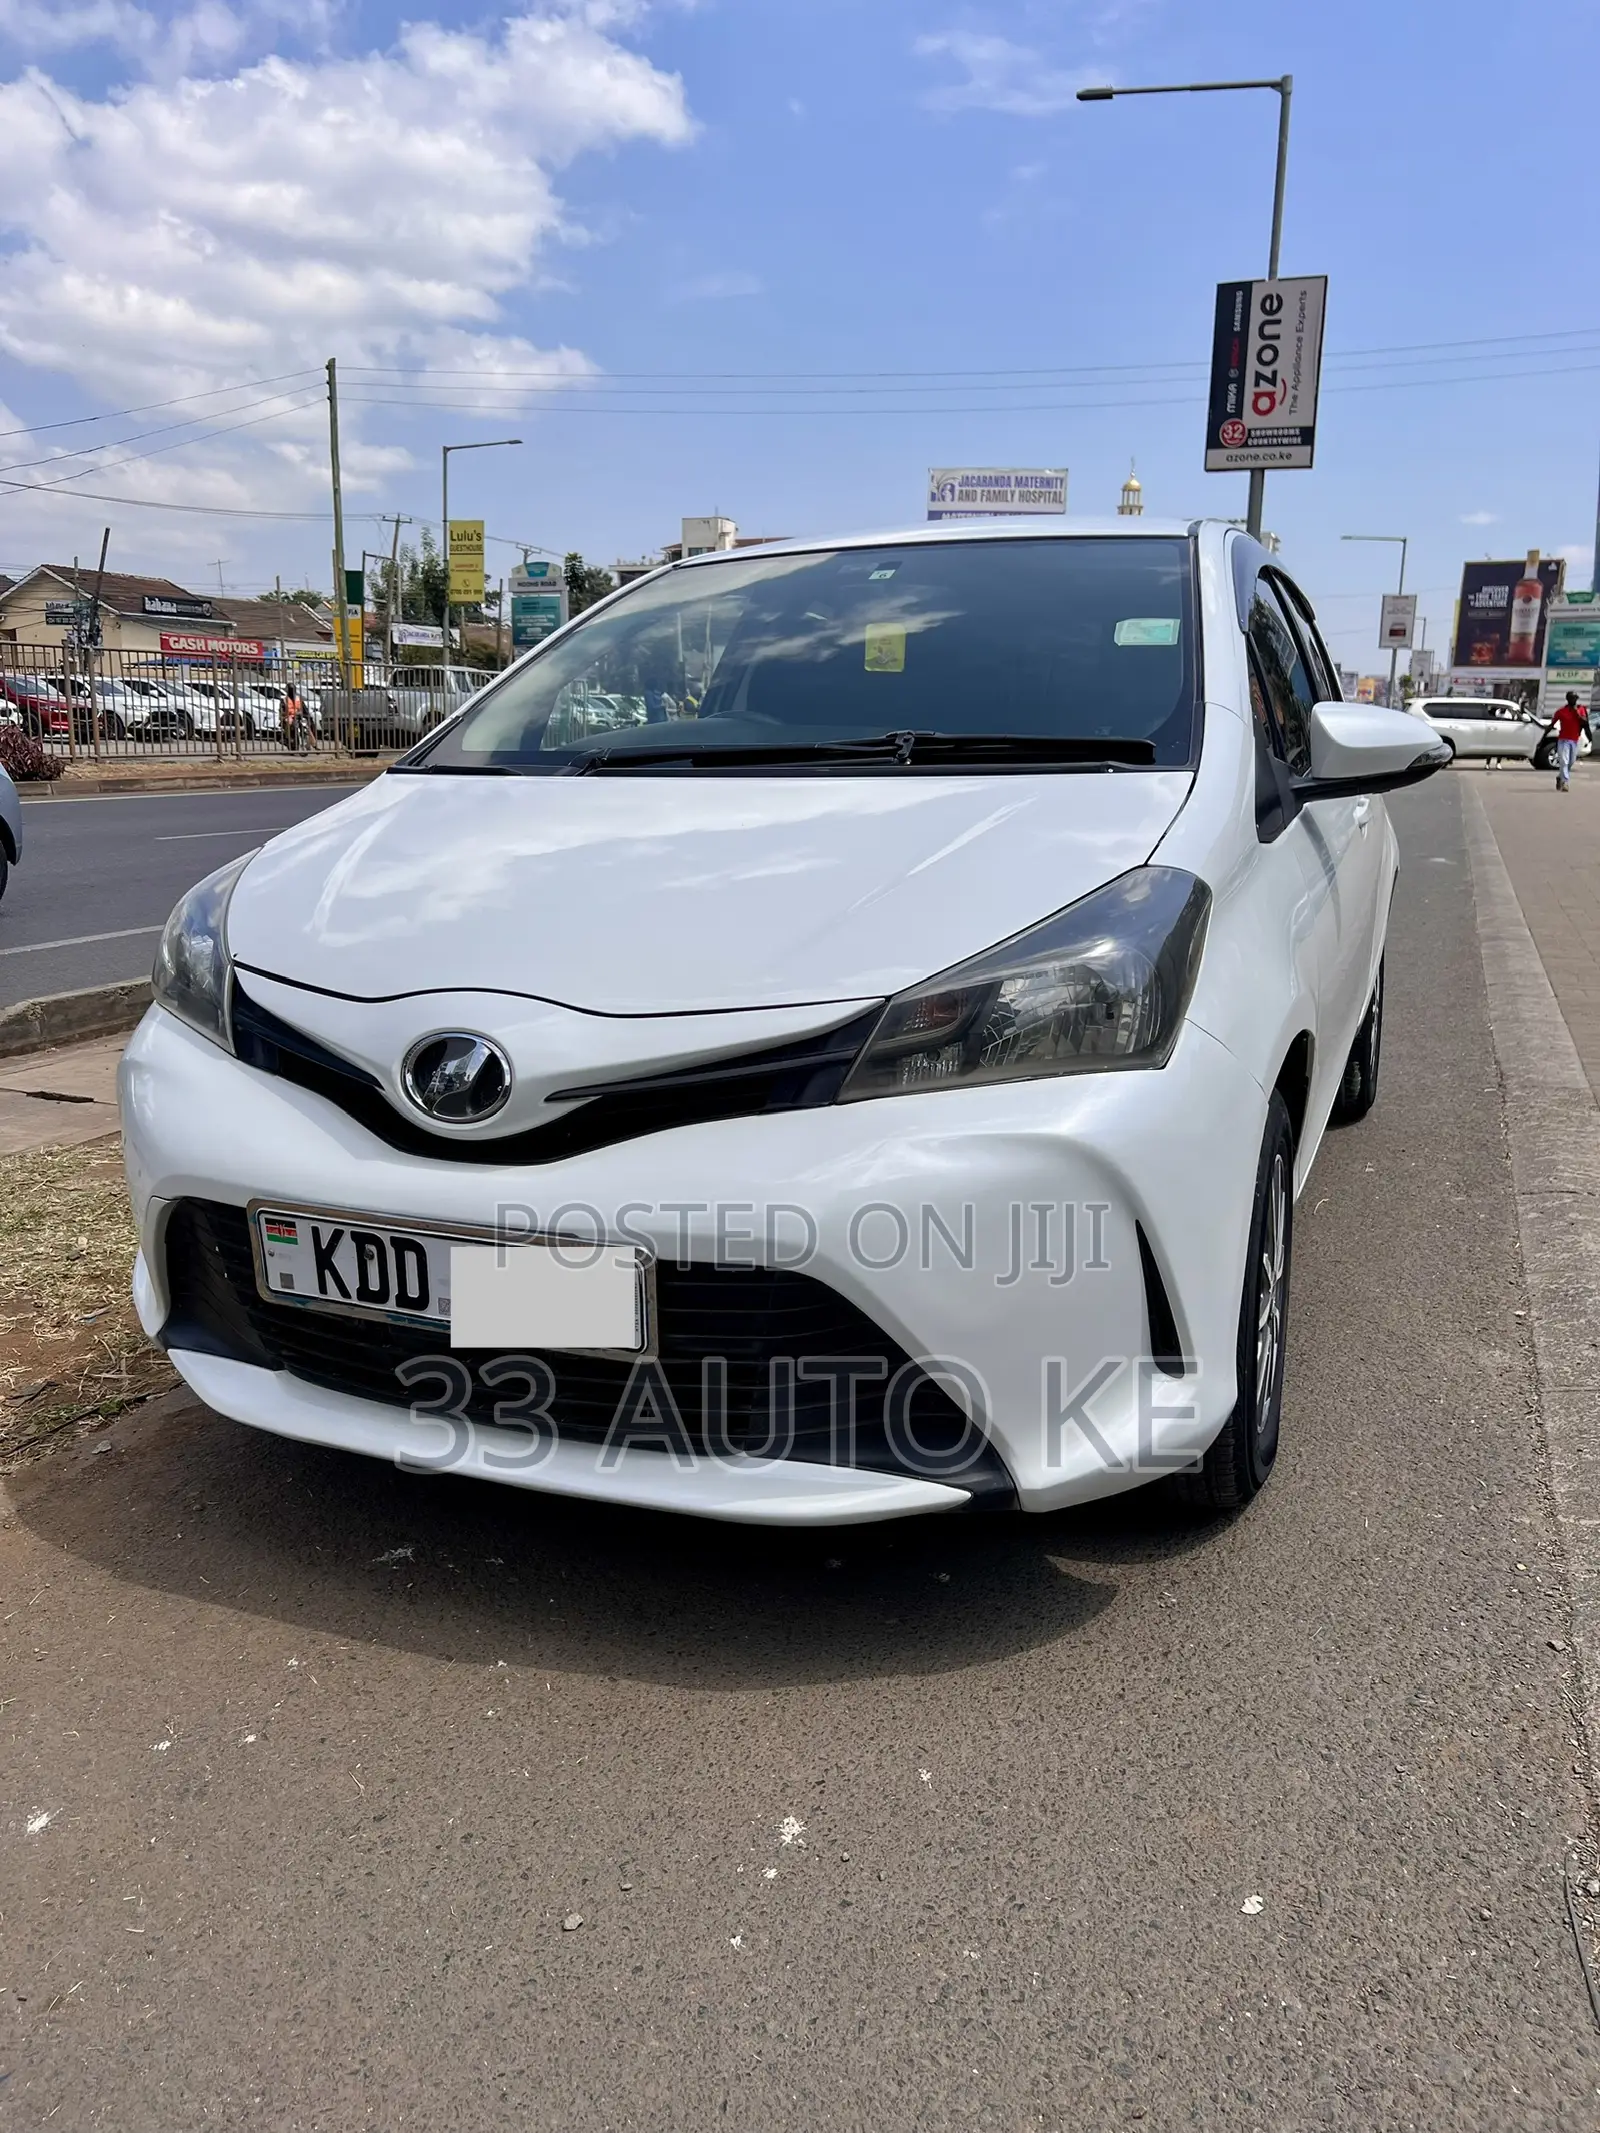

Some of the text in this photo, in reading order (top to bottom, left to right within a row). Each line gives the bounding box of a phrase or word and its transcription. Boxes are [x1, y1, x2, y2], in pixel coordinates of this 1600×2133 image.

[1252, 292, 1283, 417] azone
[1289, 290, 1308, 415] The Appliance Experts
[1223, 424, 1243, 439] 32
[1250, 428, 1300, 437] SHOWROOMS
[1247, 436, 1302, 446] COUNTRYWIDE
[1226, 451, 1292, 462] azone.co.ke
[958, 475, 1064, 489] JACARANDA MATERNITY
[957, 489, 1064, 504] AND FAMILY HOSPITAL
[450, 529, 482, 541] Lulu's
[207, 640, 258, 654] MOTORS
[310, 1224, 430, 1312] KDD
